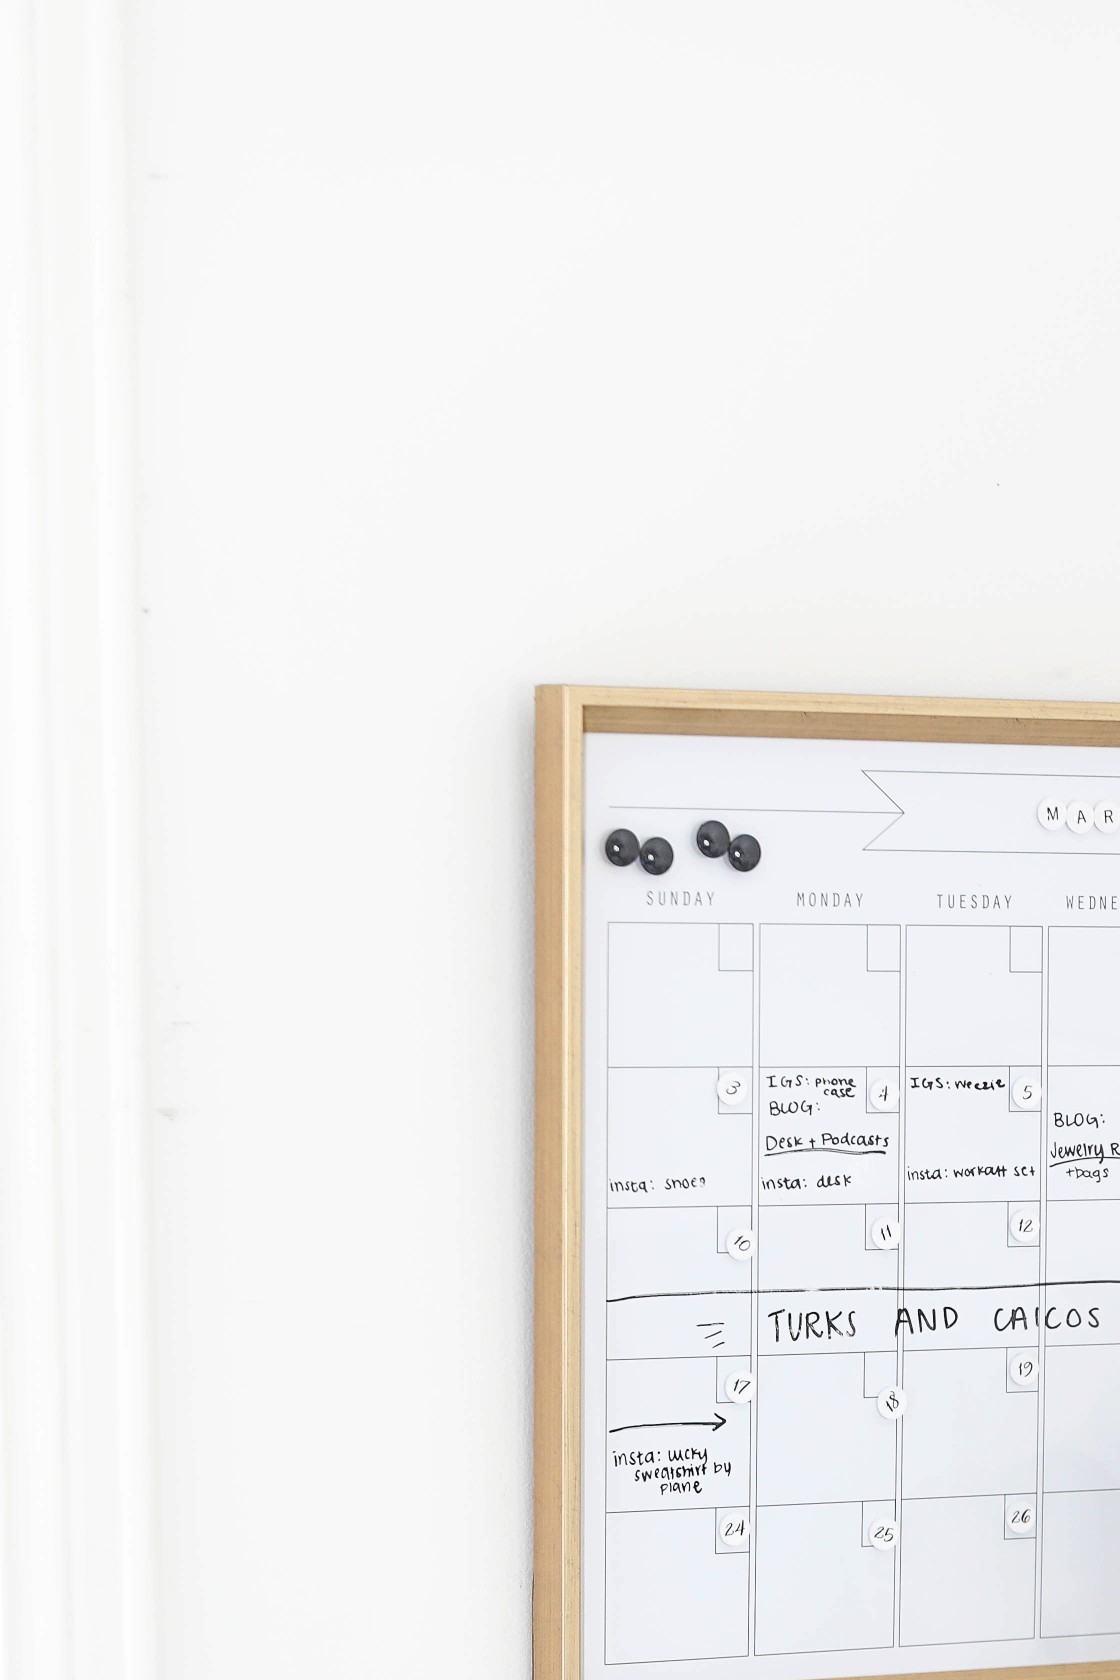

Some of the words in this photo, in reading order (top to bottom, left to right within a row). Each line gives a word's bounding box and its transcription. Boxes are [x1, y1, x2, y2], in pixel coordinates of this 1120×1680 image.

[646, 890, 715, 906] SUNDAY
[796, 892, 864, 908] MONDAY
[936, 893, 1012, 909] TUESDAY
[725, 1080, 741, 1095] 3
[765, 1074, 810, 1089] IGS:
[815, 1077, 857, 1088] phone
[909, 1076, 951, 1091] IGS:
[823, 1085, 857, 1099] case
[878, 1085, 888, 1102] 4
[1022, 1085, 1033, 1100] 5
[769, 1099, 821, 1117] BLOG:
[1053, 1111, 1106, 1129] BLOG:
[765, 1135, 803, 1151] Desk
[821, 1131, 890, 1148] Podcasts
[1050, 1141, 1105, 1164] Jewelry
[907, 1165, 948, 1181] insta:
[1013, 1165, 1036, 1177] set
[608, 1178, 655, 1194] insta:
[760, 1176, 808, 1191] insta:
[816, 1174, 852, 1189] desk
[880, 1224, 892, 1241] 11
[1018, 1218, 1033, 1233] 12
[733, 1235, 751, 1252] 10
[767, 1308, 856, 1343] TURKS
[894, 1306, 959, 1337] AND
[992, 1305, 1101, 1333] CAICOS
[1018, 1361, 1033, 1378] 19
[733, 1378, 751, 1395] 17
[885, 1391, 900, 1412] 18
[612, 1450, 661, 1468] insta:
[667, 1447, 708, 1466] lucky
[634, 1464, 708, 1482] sweatshirt
[713, 1461, 732, 1477] by
[659, 1480, 703, 1496] plane
[1011, 1508, 1031, 1524] 26
[724, 1519, 745, 1537] 24
[873, 1526, 894, 1543] 25
